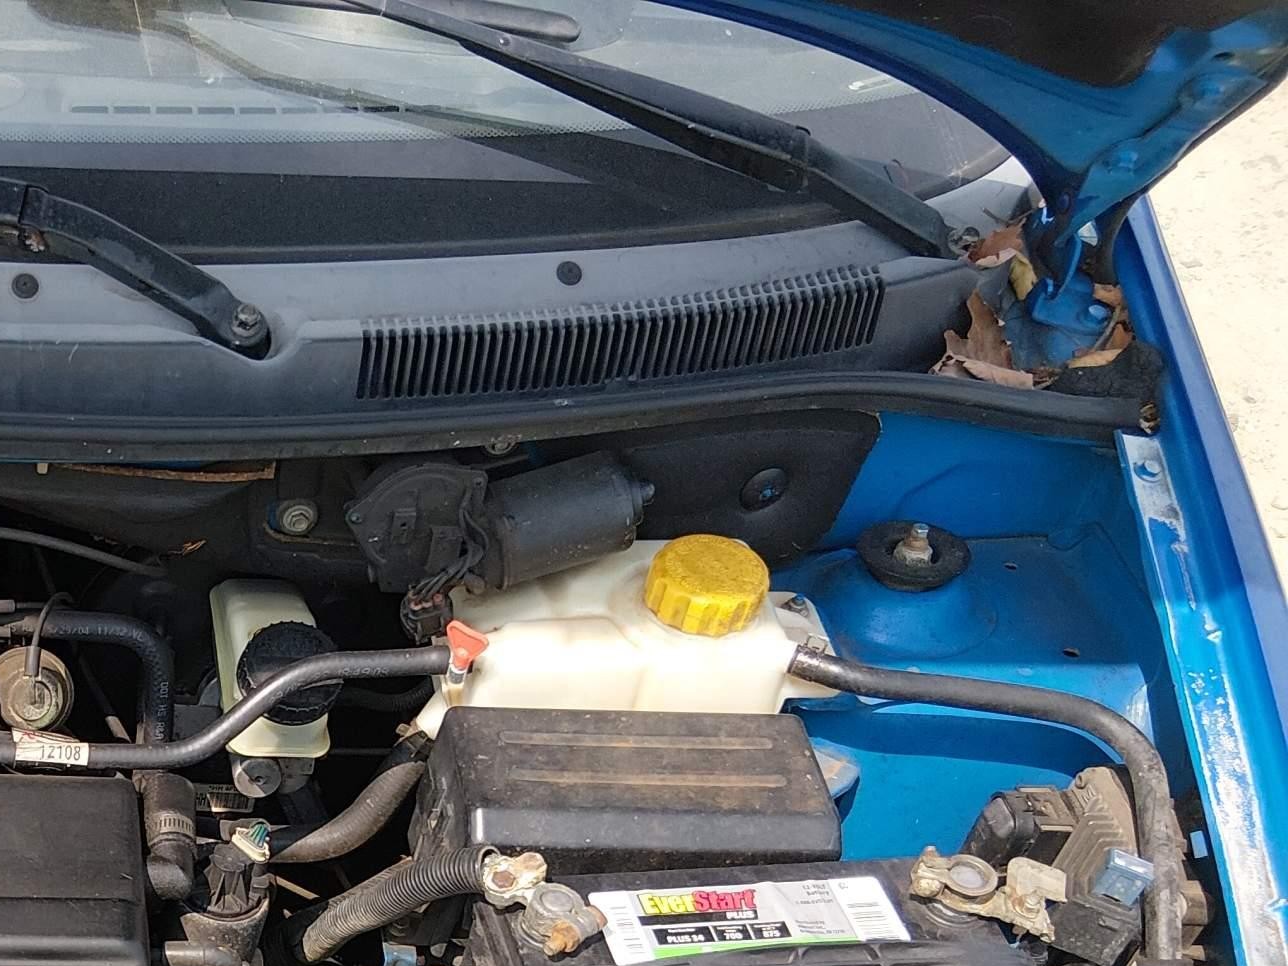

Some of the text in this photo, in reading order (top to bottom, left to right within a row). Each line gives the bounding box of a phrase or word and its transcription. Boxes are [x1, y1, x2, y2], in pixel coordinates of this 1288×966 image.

[39, 744, 81, 761] 12108
[636, 889, 756, 915] EverStart
[725, 910, 755, 920] PLUS
[666, 935, 690, 944] PLUS
